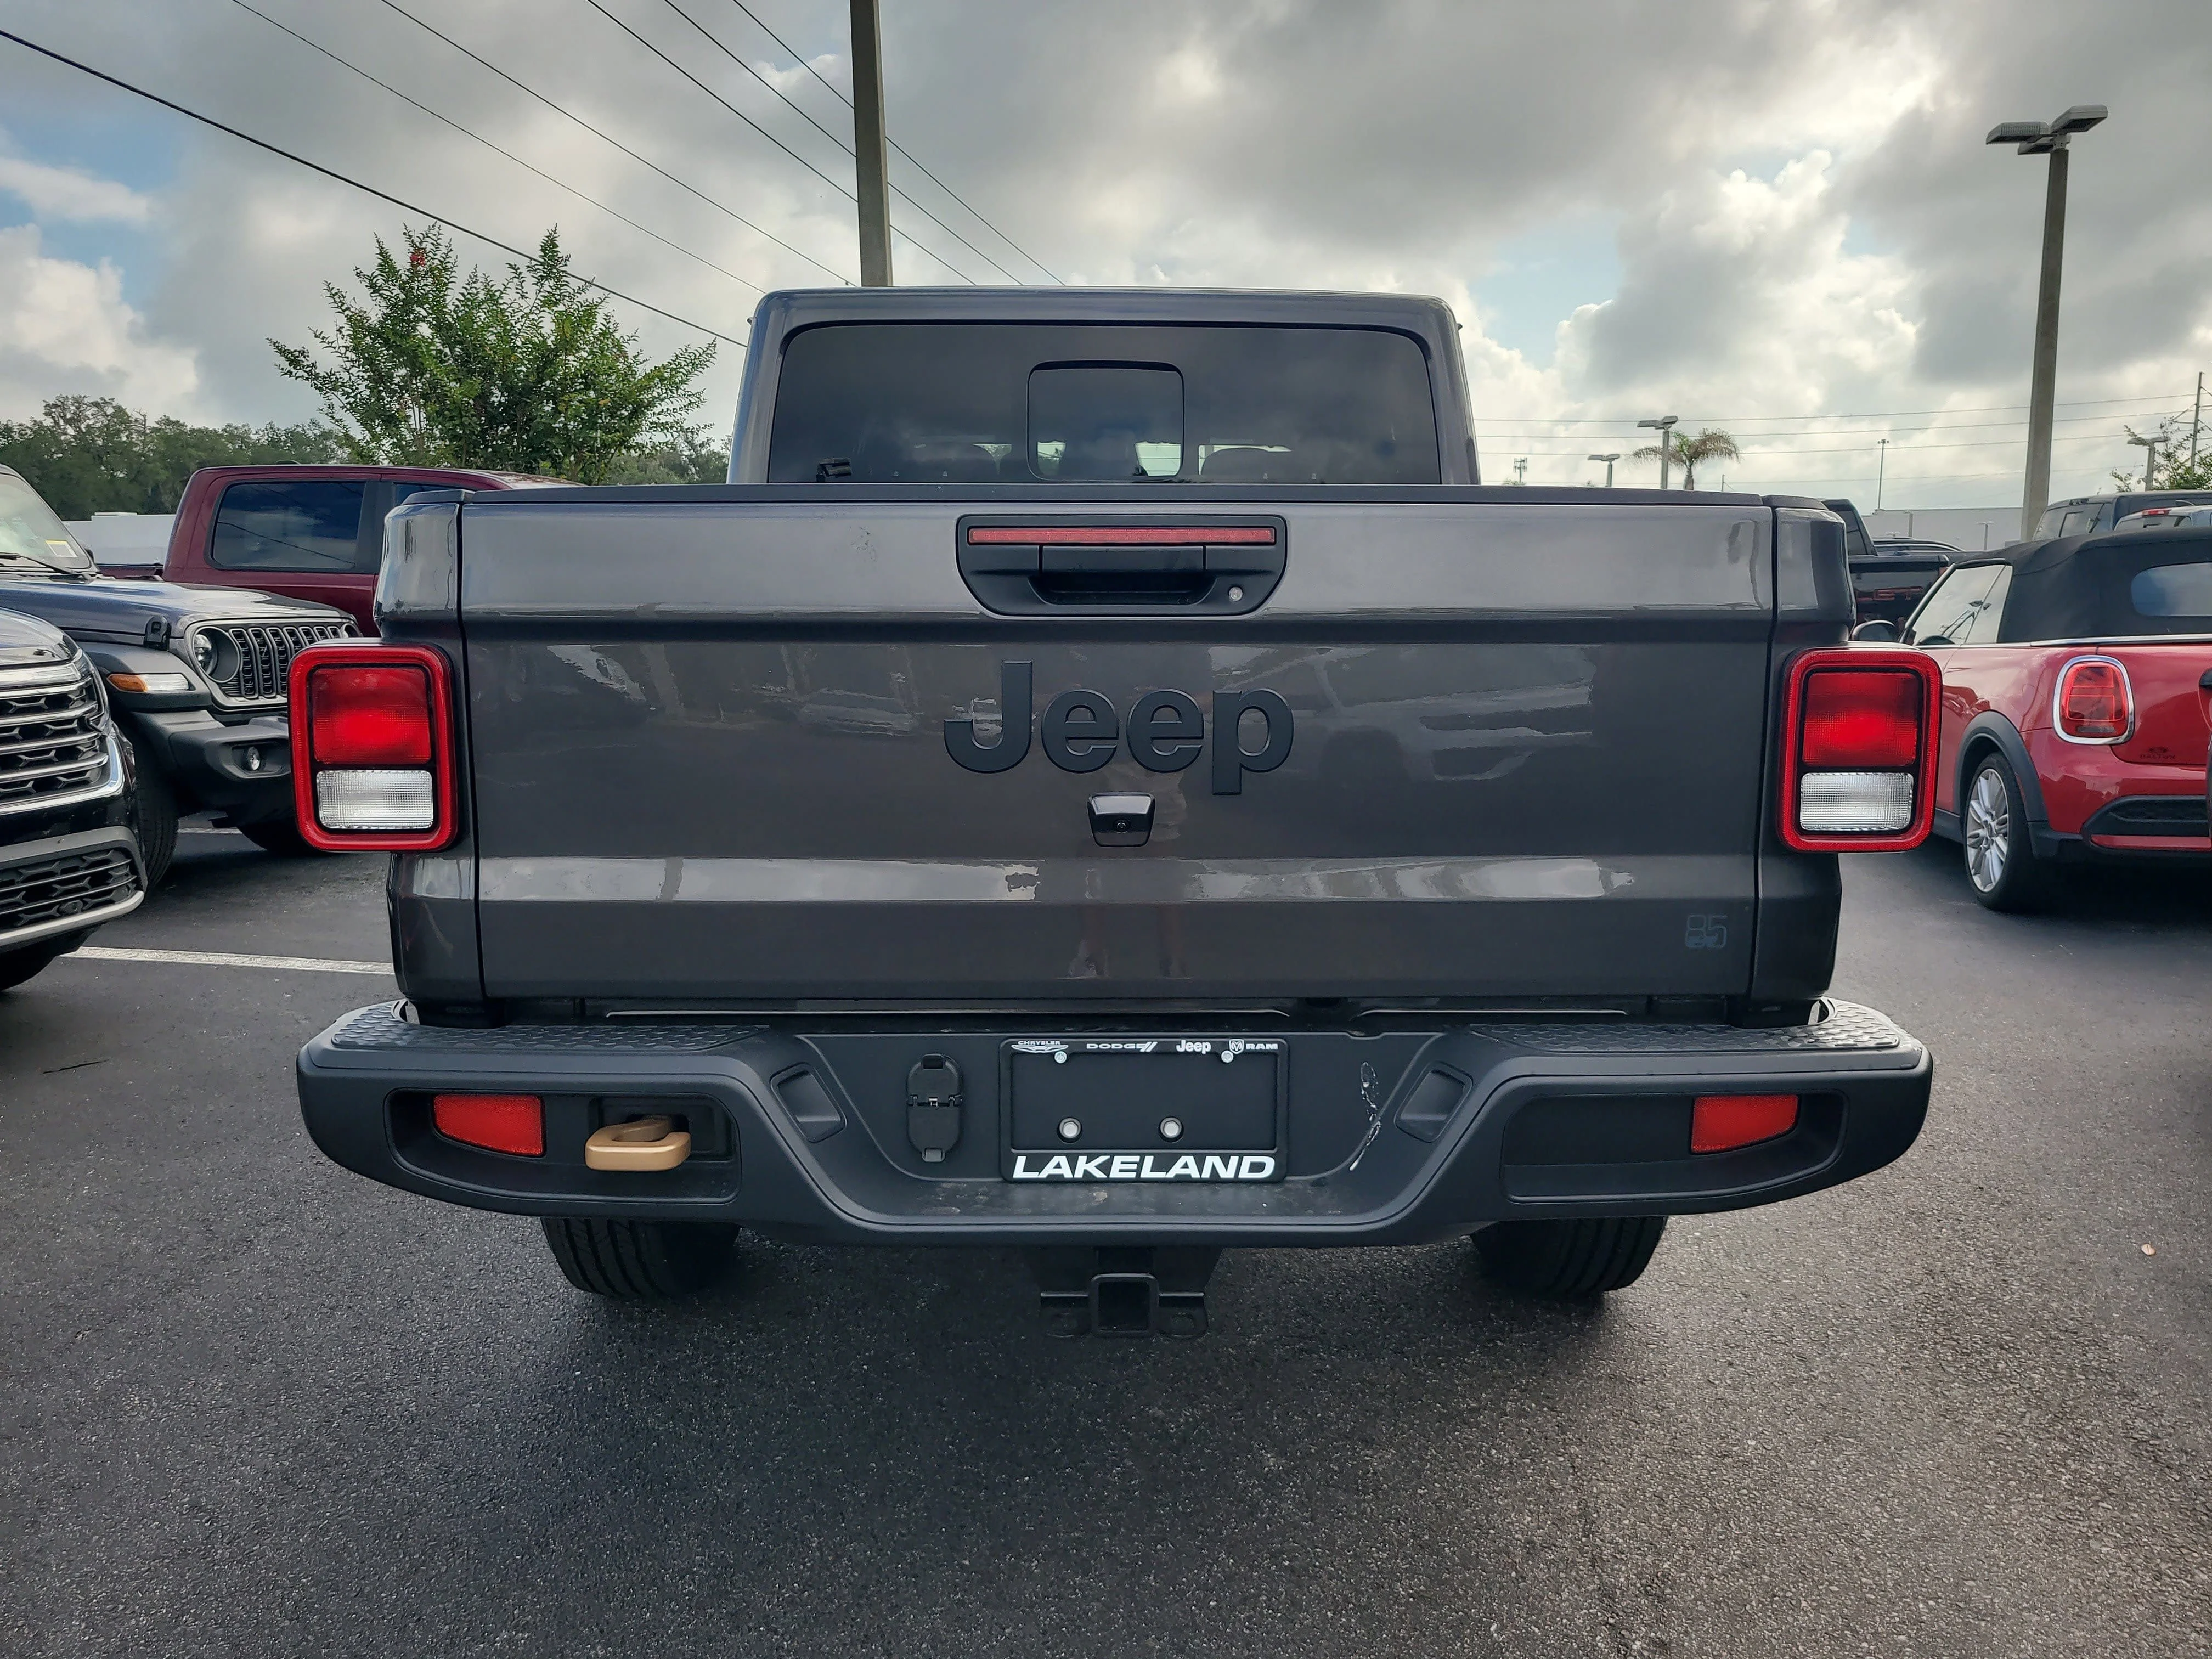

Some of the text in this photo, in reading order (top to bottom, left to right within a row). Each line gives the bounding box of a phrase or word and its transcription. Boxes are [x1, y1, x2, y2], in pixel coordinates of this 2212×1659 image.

[944, 659, 1294, 795] Jeep
[1176, 1039, 1211, 1054] Jeep
[1012, 1155, 1276, 1179] LAKELAND
